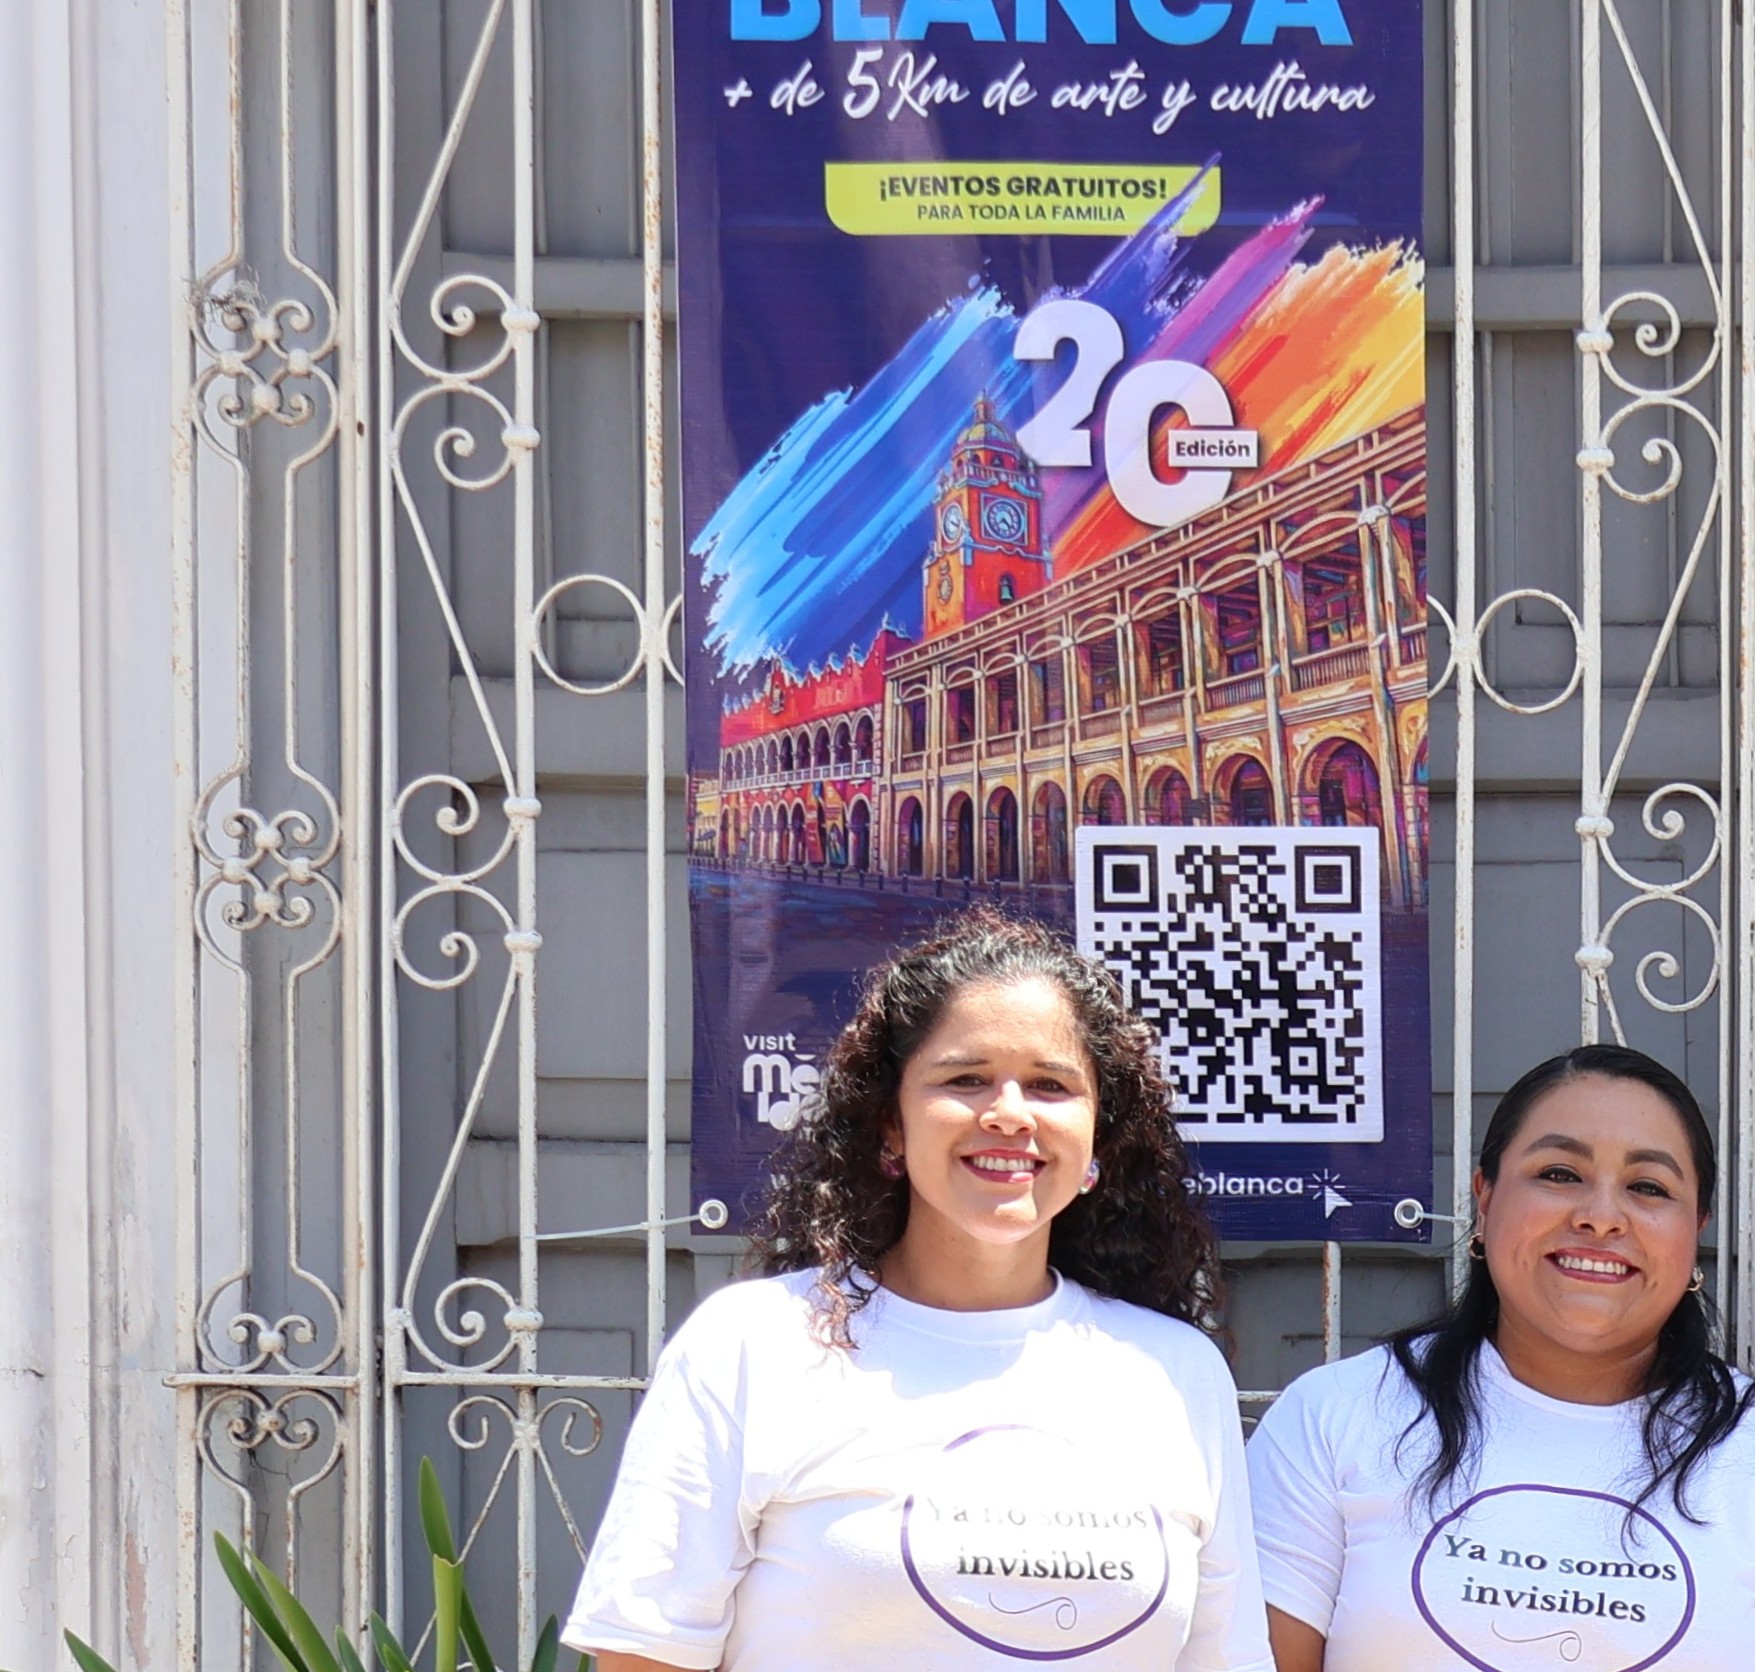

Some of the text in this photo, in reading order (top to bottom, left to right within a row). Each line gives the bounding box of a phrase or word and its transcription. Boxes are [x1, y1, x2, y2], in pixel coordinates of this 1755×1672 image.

[771, 58, 825, 116] de
[982, 59, 1038, 115] de
[1051, 58, 1147, 117] arte
[1152, 79, 1197, 135] y
[1210, 58, 1376, 120] cultura
[880, 176, 1168, 201] ¡EVENTOS GRATUITOS!
[917, 204, 1126, 221] PARA TODA LA FAMILIA
[1175, 439, 1250, 457] Edición
[1180, 1172, 1304, 1195] eblanca
[956, 1546, 1135, 1581] invisibles
[1444, 1534, 1678, 1581] Ya no somos
[1461, 1576, 1647, 1623] invisibles
